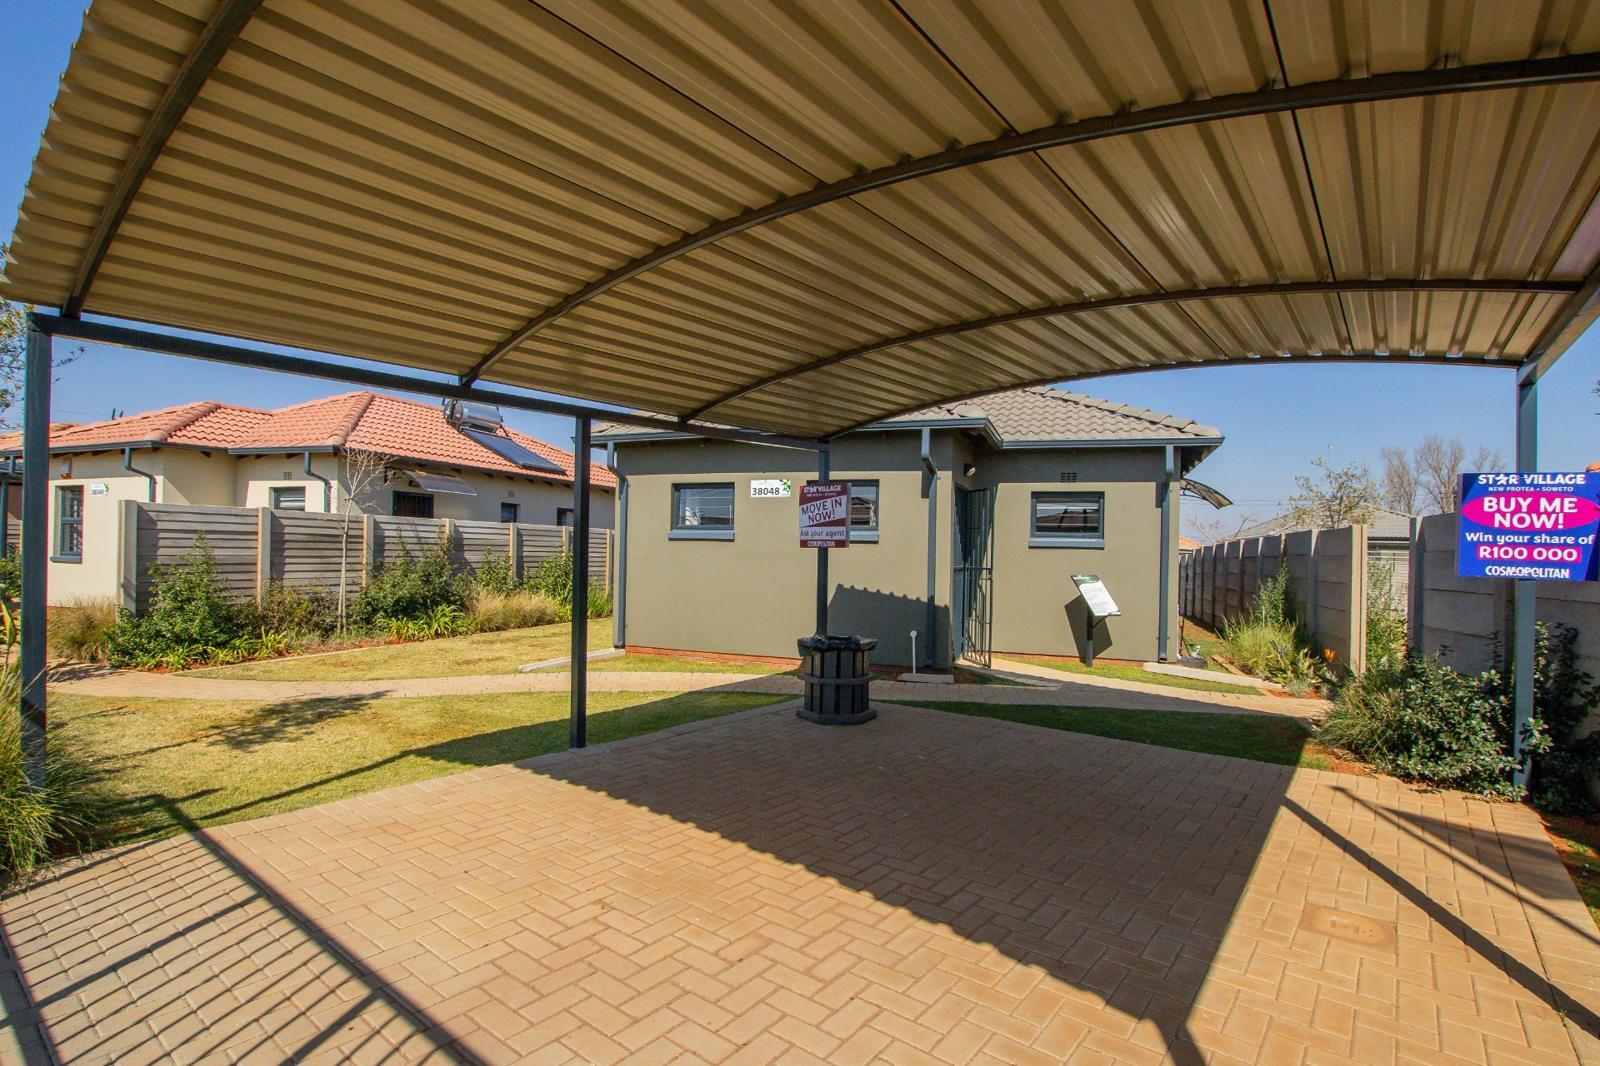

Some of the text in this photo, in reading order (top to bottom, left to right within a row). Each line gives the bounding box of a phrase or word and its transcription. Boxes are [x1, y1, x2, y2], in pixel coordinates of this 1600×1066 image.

[1524, 474, 1586, 485] VILLAGE
[752, 488, 780, 496] 38048
[801, 498, 842, 515] MOVE IN
[1483, 497, 1578, 513] BUY ME
[808, 509, 836, 525] NOW!
[1494, 513, 1564, 529] NOW!
[826, 530, 844, 538] agent
[1465, 532, 1596, 545] Win your share of
[1479, 546, 1578, 561] R100 000
[1485, 565, 1570, 579] COSMOPOLITAN
